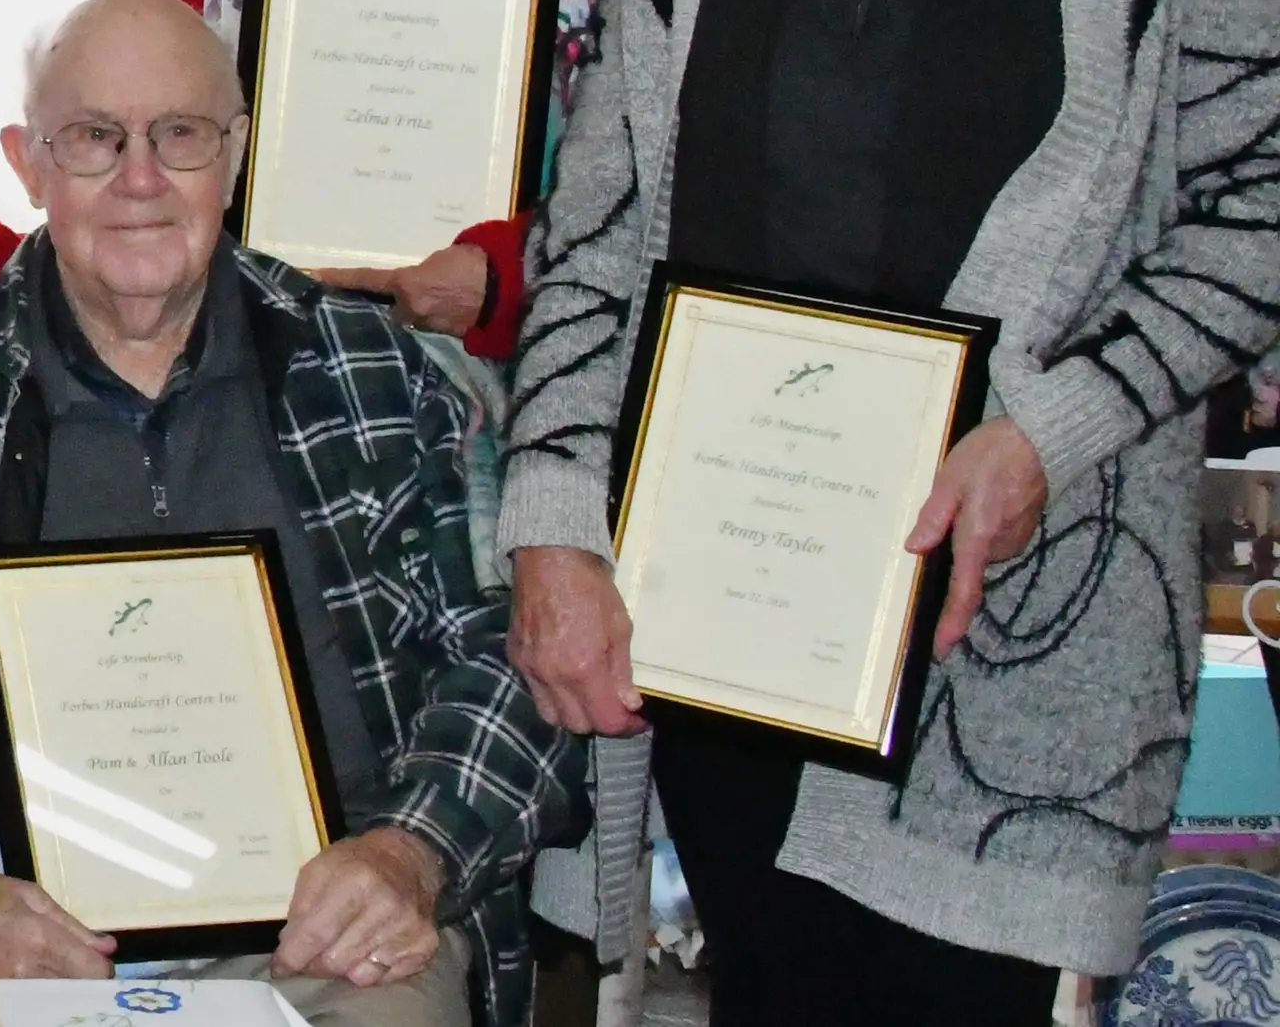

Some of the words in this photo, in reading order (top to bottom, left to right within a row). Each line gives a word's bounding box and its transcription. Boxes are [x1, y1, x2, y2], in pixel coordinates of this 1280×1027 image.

[352, 52, 415, 71] Handicraft
[345, 108, 390, 126] Zelma
[738, 459, 808, 486] Handicraft
[811, 475, 854, 494] Centre
[857, 484, 880, 500] Inc
[719, 520, 767, 547] Penny
[772, 531, 826, 555] Taylor
[102, 695, 171, 711] Handicraft
[175, 693, 215, 707] Centre
[218, 691, 239, 704] Inc
[87, 757, 122, 770] Pam
[126, 757, 137, 769] &
[143, 750, 188, 770] Allan
[192, 747, 234, 765] Toole
